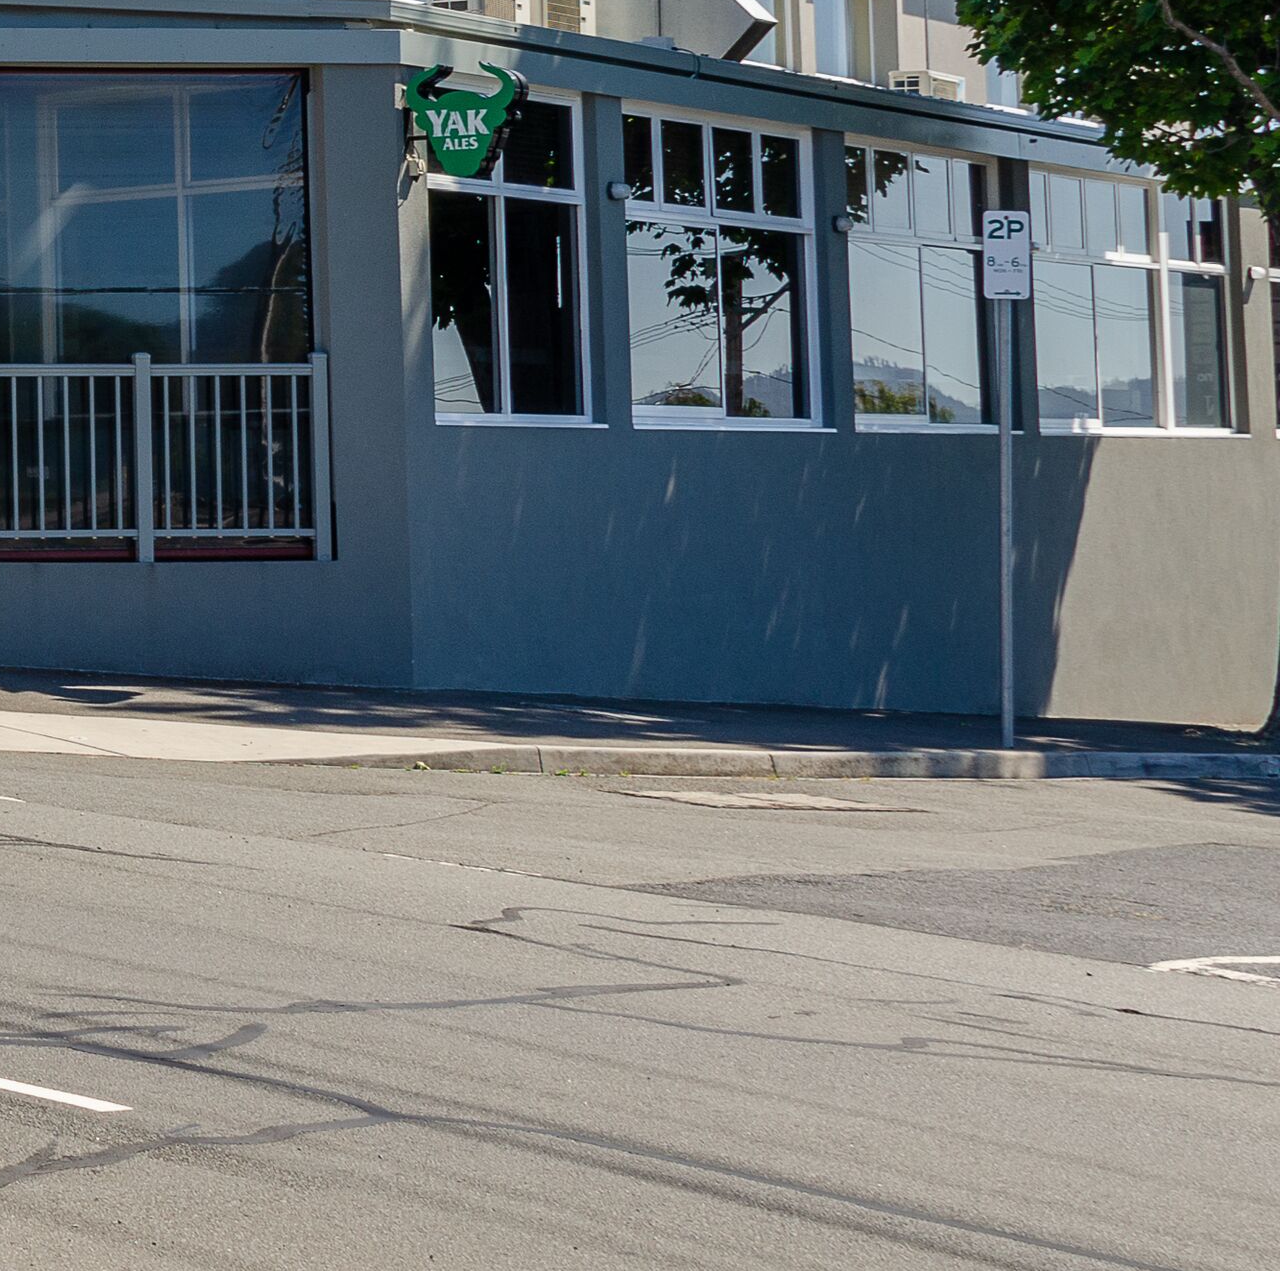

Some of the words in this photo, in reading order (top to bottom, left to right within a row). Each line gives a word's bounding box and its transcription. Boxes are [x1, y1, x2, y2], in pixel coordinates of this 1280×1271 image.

[425, 109, 490, 137] YAK
[443, 136, 479, 150] ALES
[987, 218, 1025, 239] 2P
